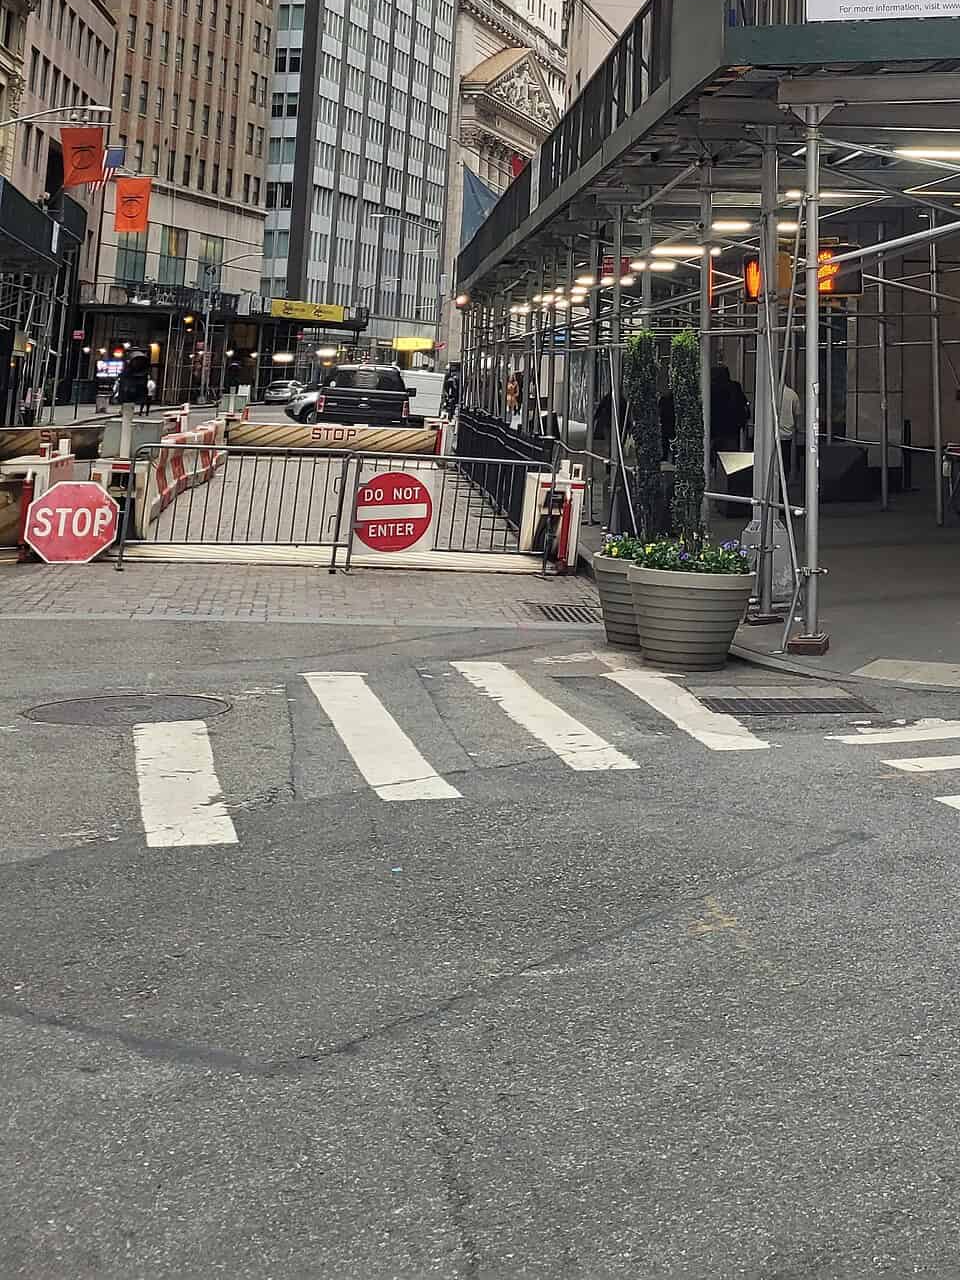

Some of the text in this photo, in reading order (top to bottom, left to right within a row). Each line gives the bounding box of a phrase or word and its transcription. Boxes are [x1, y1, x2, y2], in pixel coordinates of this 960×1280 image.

[839, 5, 851, 13] For
[876, 2, 922, 12] information,
[924, 2, 940, 11] visit
[312, 428, 357, 441] STOP
[364, 487, 421, 502] DO NOT
[33, 507, 113, 537] STOP
[368, 523, 415, 537] ENTER
